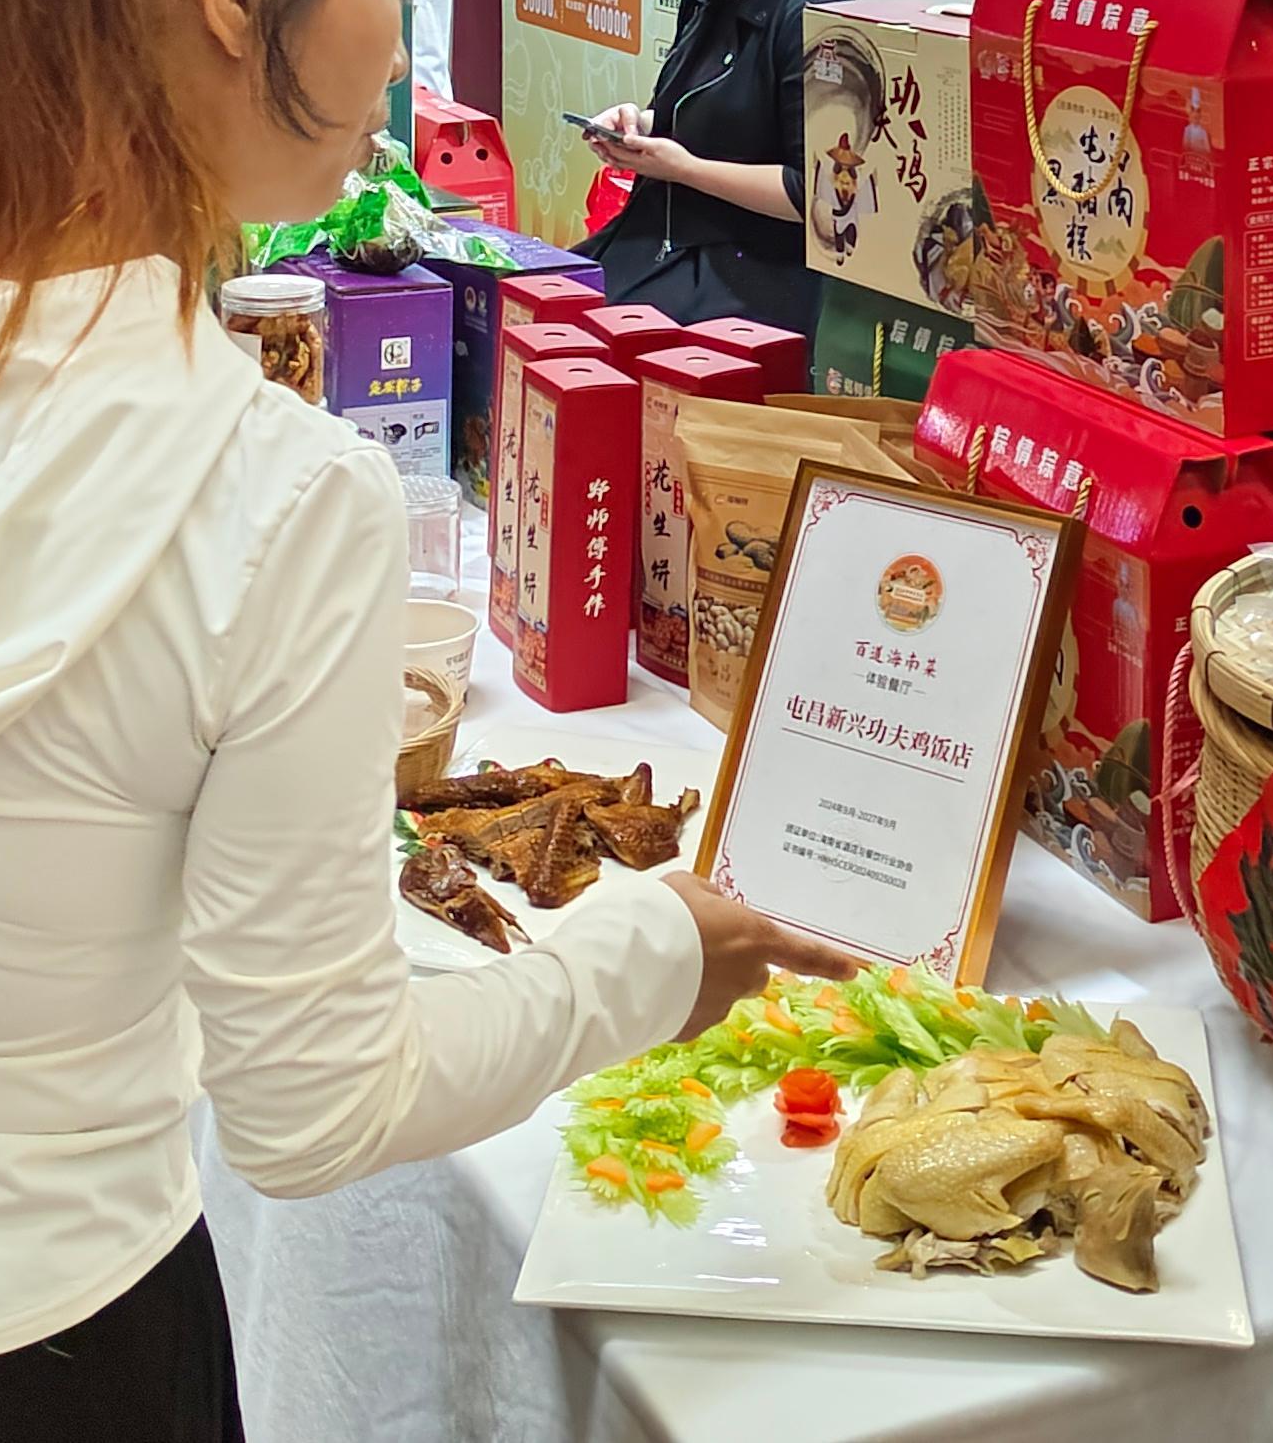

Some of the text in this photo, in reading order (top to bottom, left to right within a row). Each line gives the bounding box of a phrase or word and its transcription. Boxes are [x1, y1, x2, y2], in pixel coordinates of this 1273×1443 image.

[785, 694, 975, 771] 屯昌新兴功夫鸡饭店
